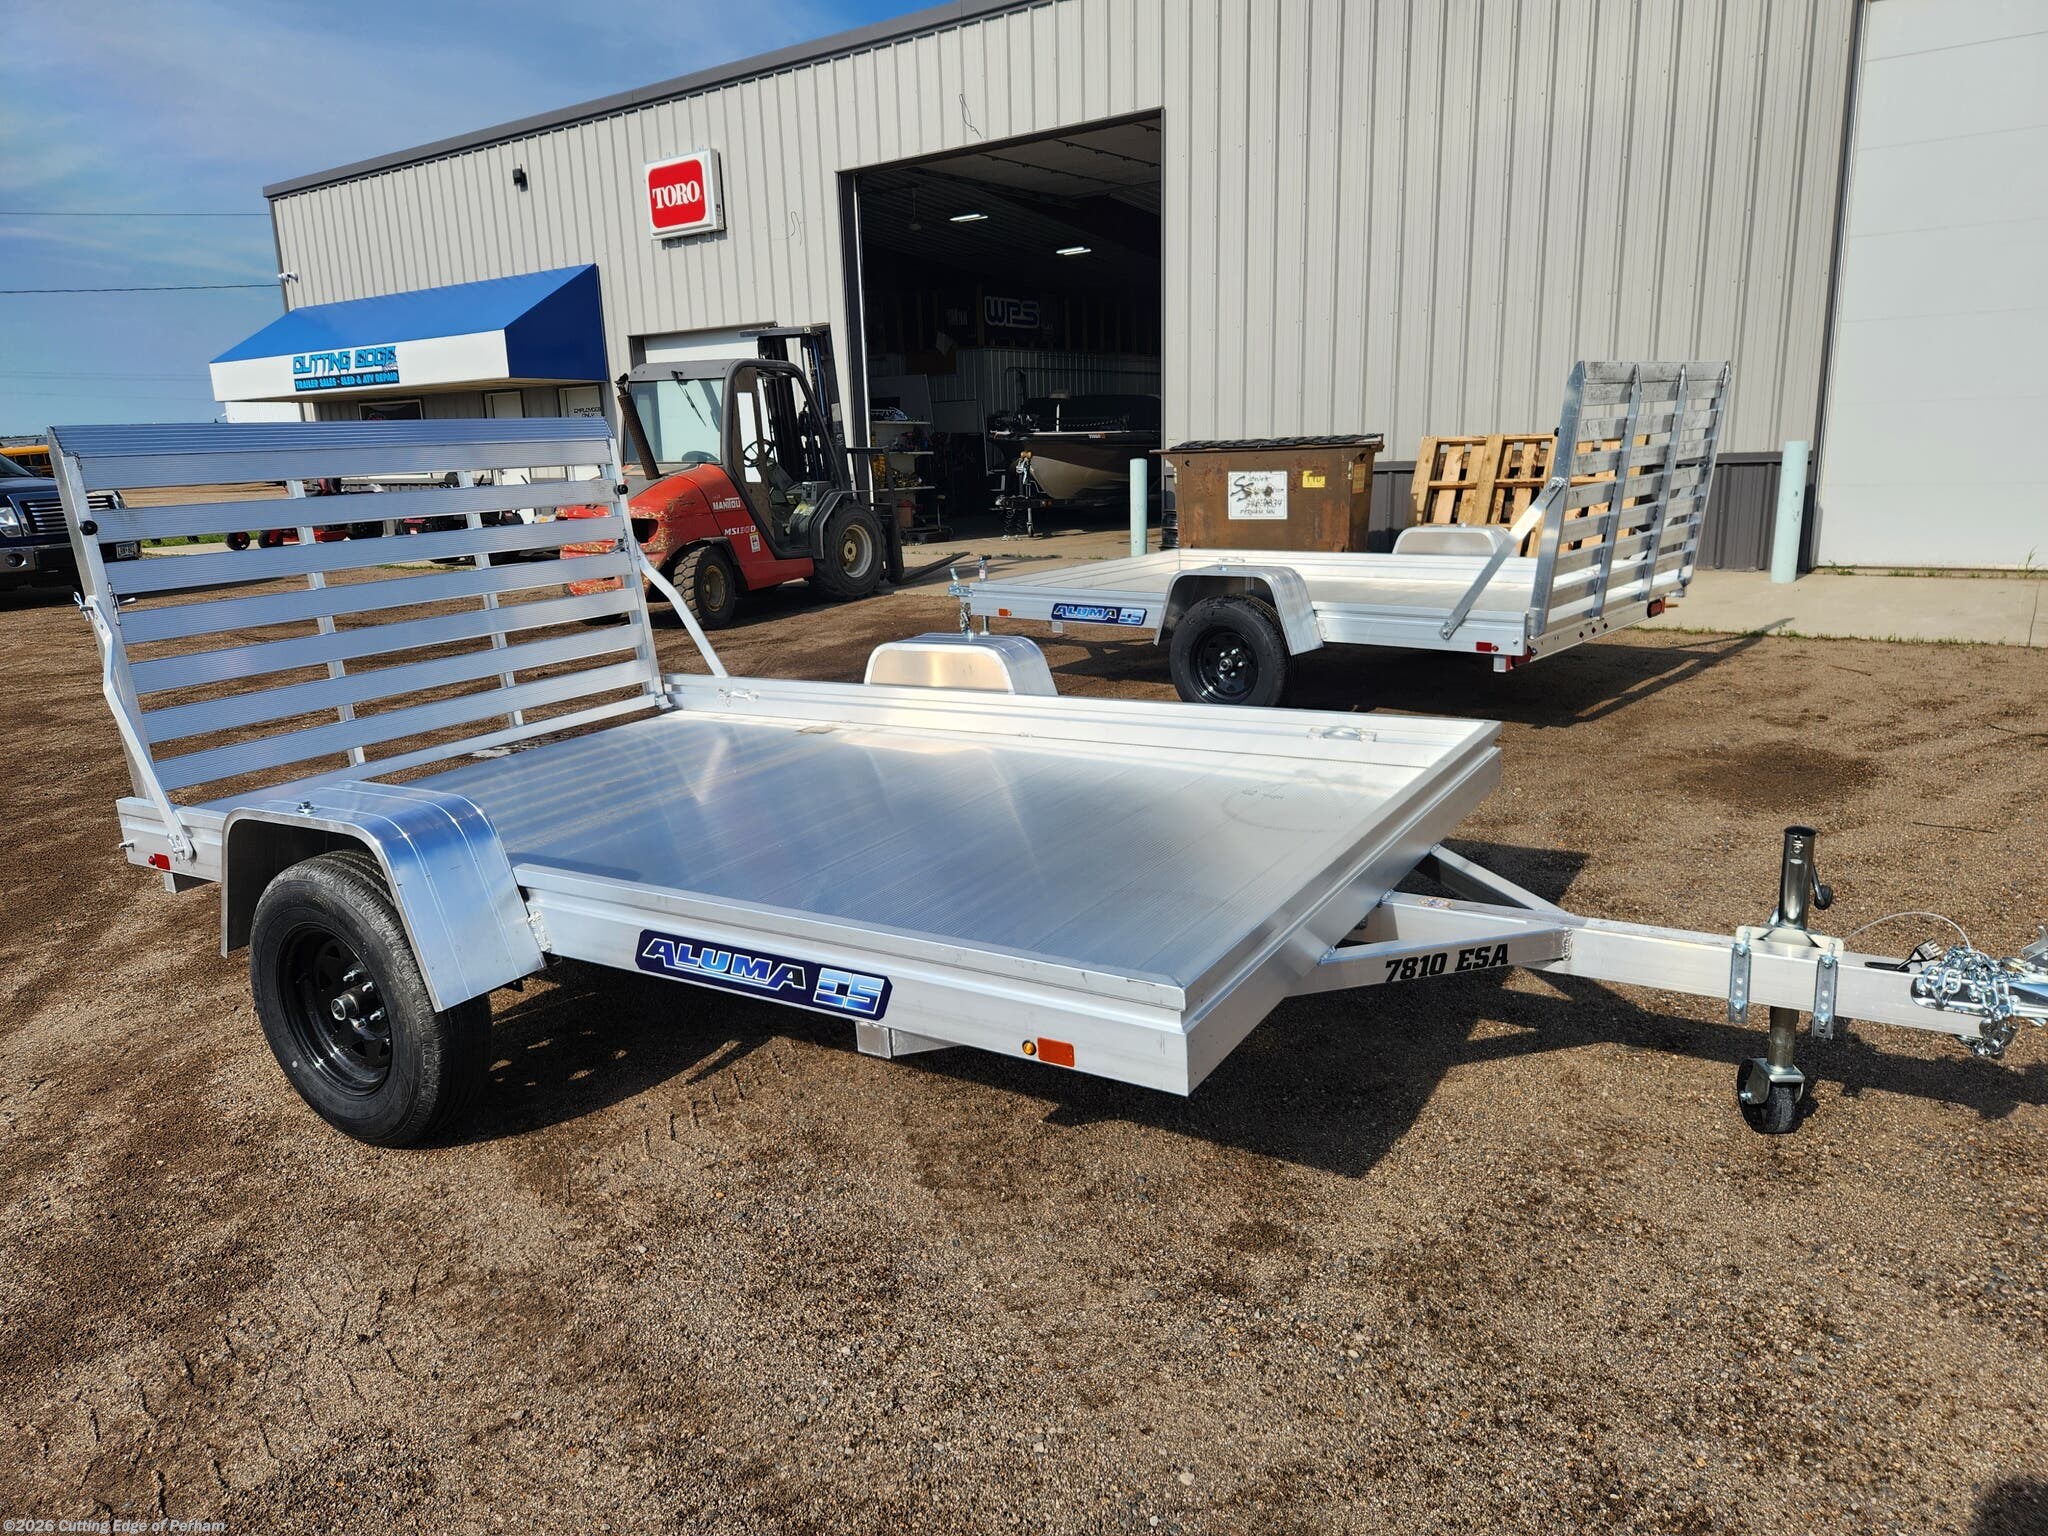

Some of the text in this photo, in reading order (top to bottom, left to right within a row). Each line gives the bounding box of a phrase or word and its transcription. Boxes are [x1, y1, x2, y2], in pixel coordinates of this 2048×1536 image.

[652, 180, 700, 209] TORO
[984, 296, 1040, 328] WPS
[293, 346, 397, 375] CUTTING EDGE
[296, 378, 319, 389] TRAILER
[320, 377, 337, 387] SALES
[340, 375, 355, 385] SLED
[363, 373, 374, 383] ATV
[375, 371, 398, 382] REPAIR
[713, 497, 741, 510] MANITOU
[1053, 605, 1117, 621] ALUMA
[642, 938, 806, 991] ALUMA
[1385, 944, 1509, 982] 7810 ESA
